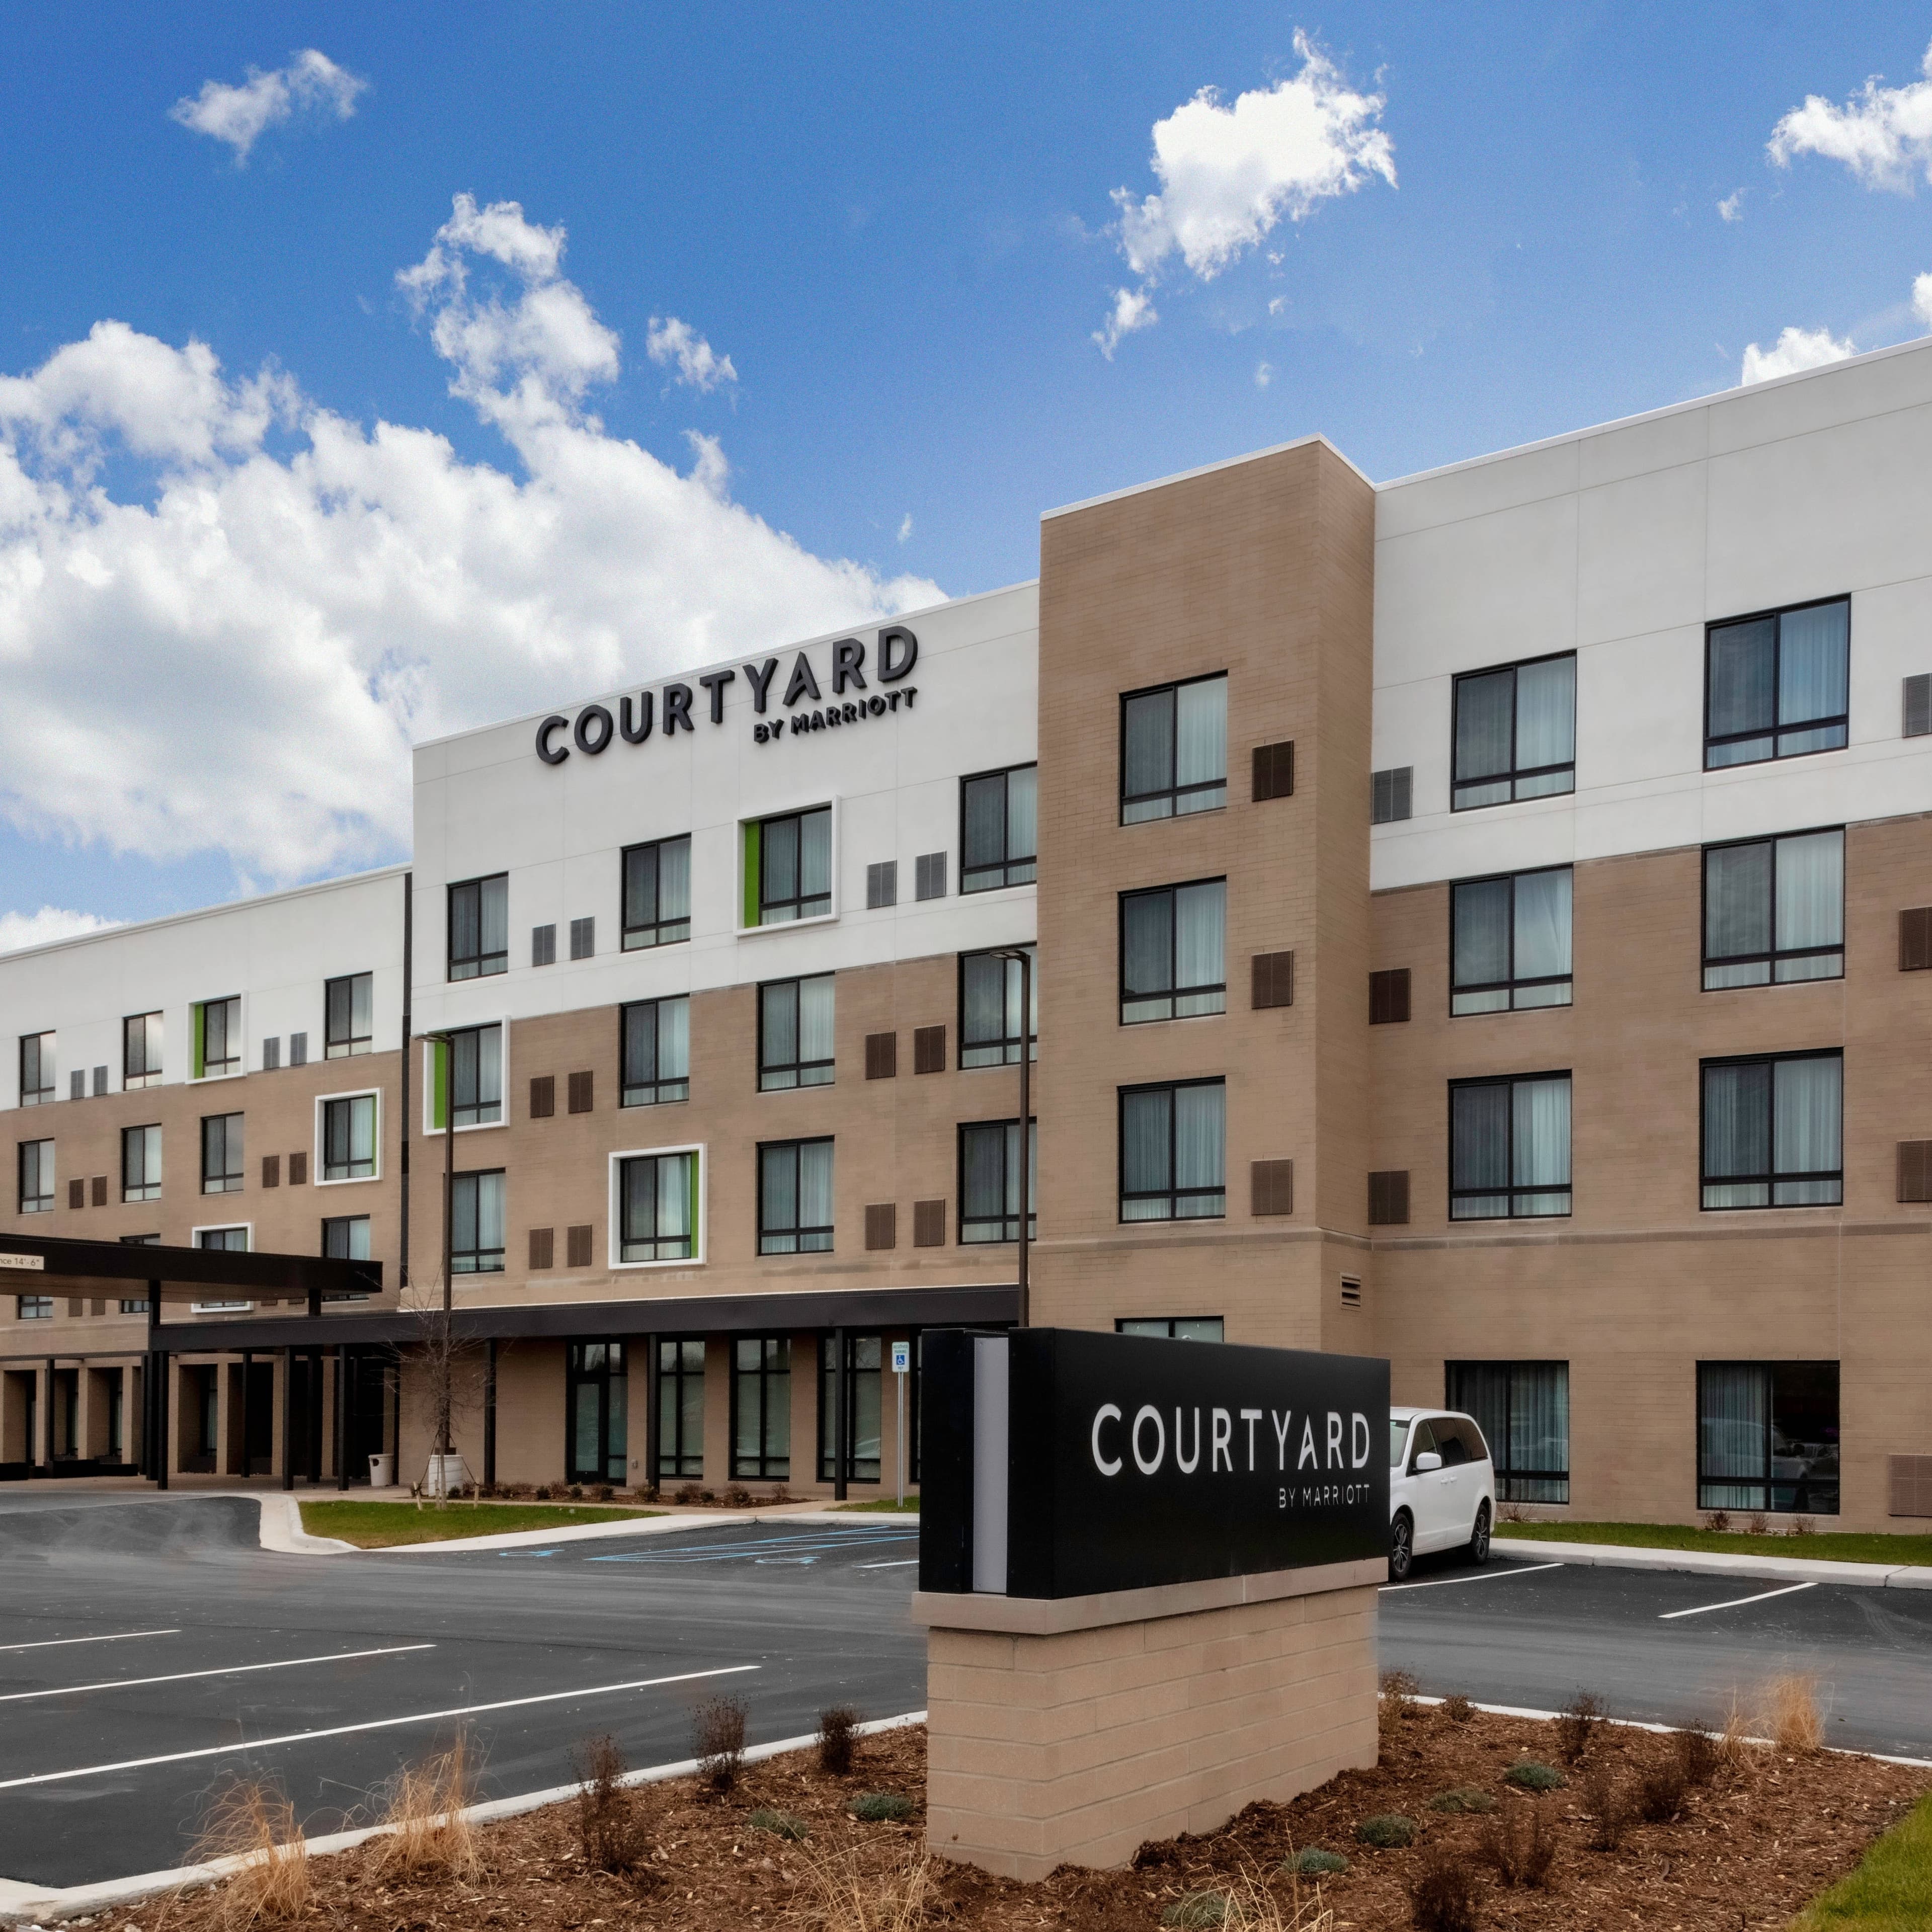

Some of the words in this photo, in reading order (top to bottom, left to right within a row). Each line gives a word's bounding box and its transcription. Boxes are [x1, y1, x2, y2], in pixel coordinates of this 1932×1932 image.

[536, 625, 918, 765] COURTYARD
[754, 719, 785, 744] BY
[790, 686, 918, 736] MARRIOTT
[1091, 1403, 1370, 1476] COURTYARD
[1279, 1488, 1296, 1508] BY
[1303, 1484, 1370, 1506] MARRIOTT
